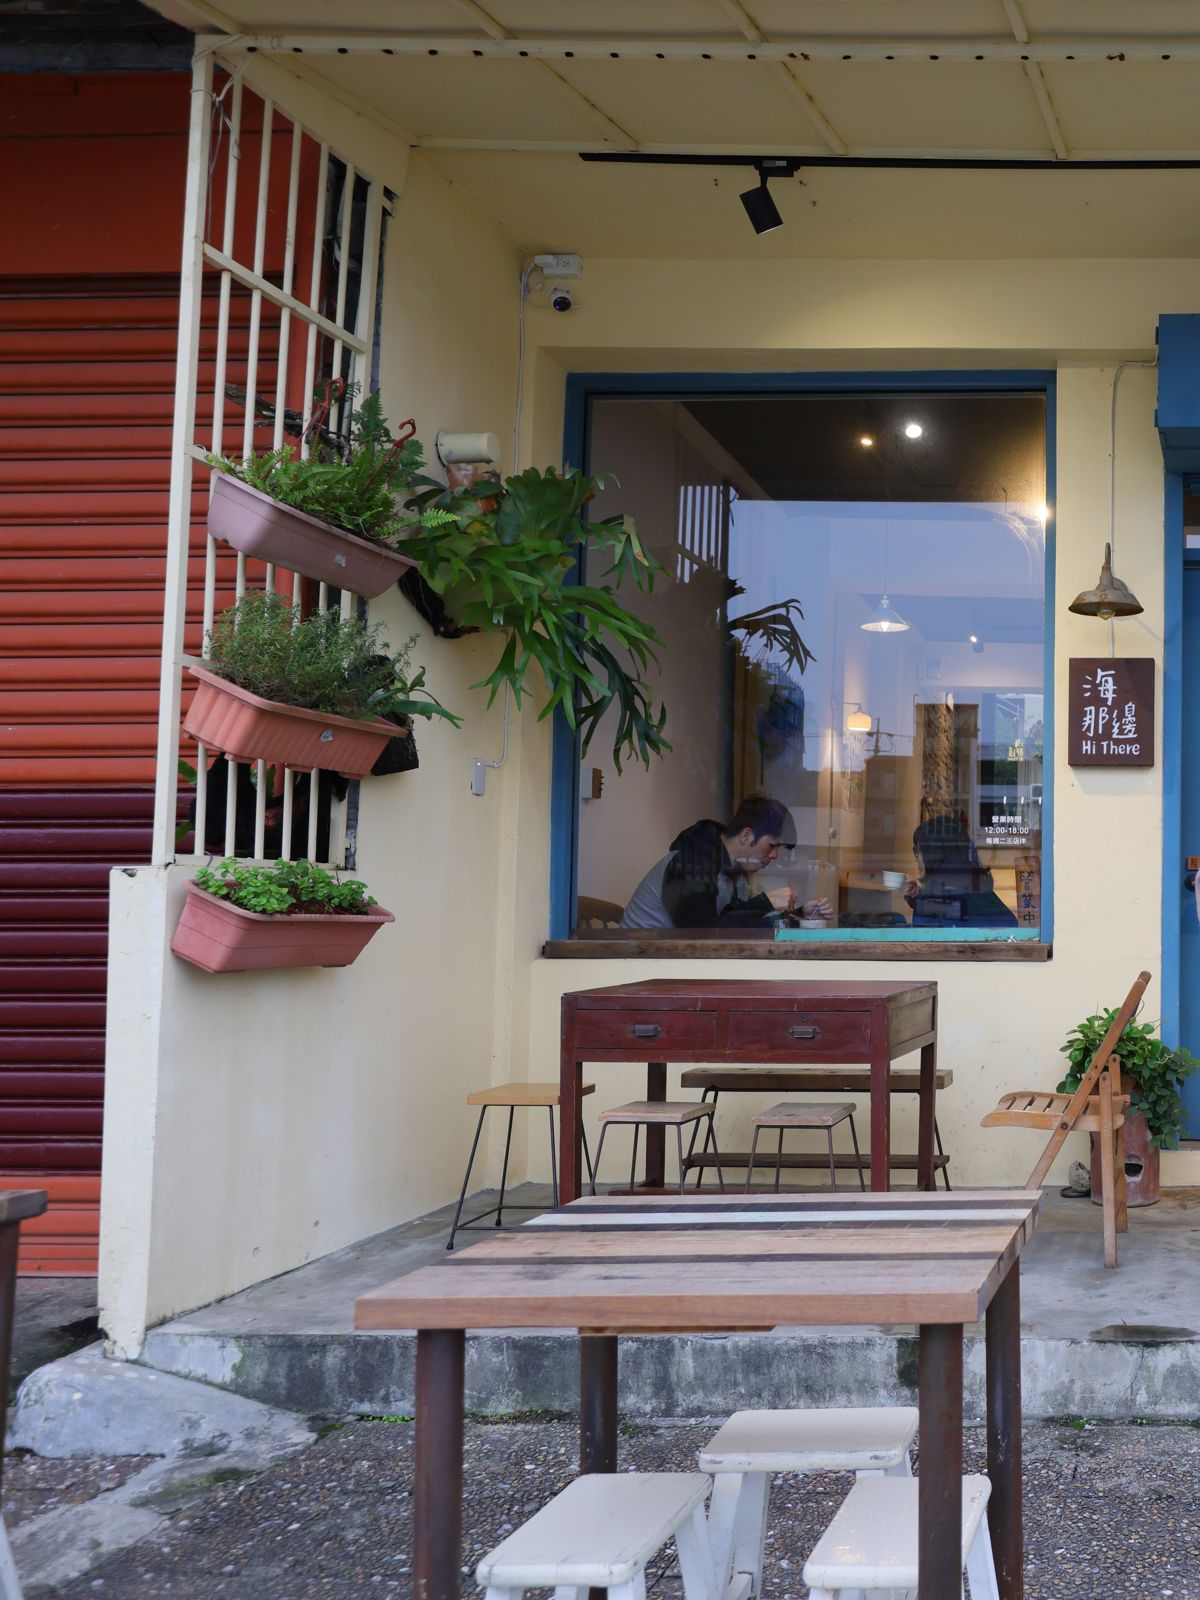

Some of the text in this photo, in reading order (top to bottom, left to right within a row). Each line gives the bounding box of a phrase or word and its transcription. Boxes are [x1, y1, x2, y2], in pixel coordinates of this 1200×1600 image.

[1082, 740, 1140, 755] Hi There
[984, 826, 1029, 834] 12:00-18:00
